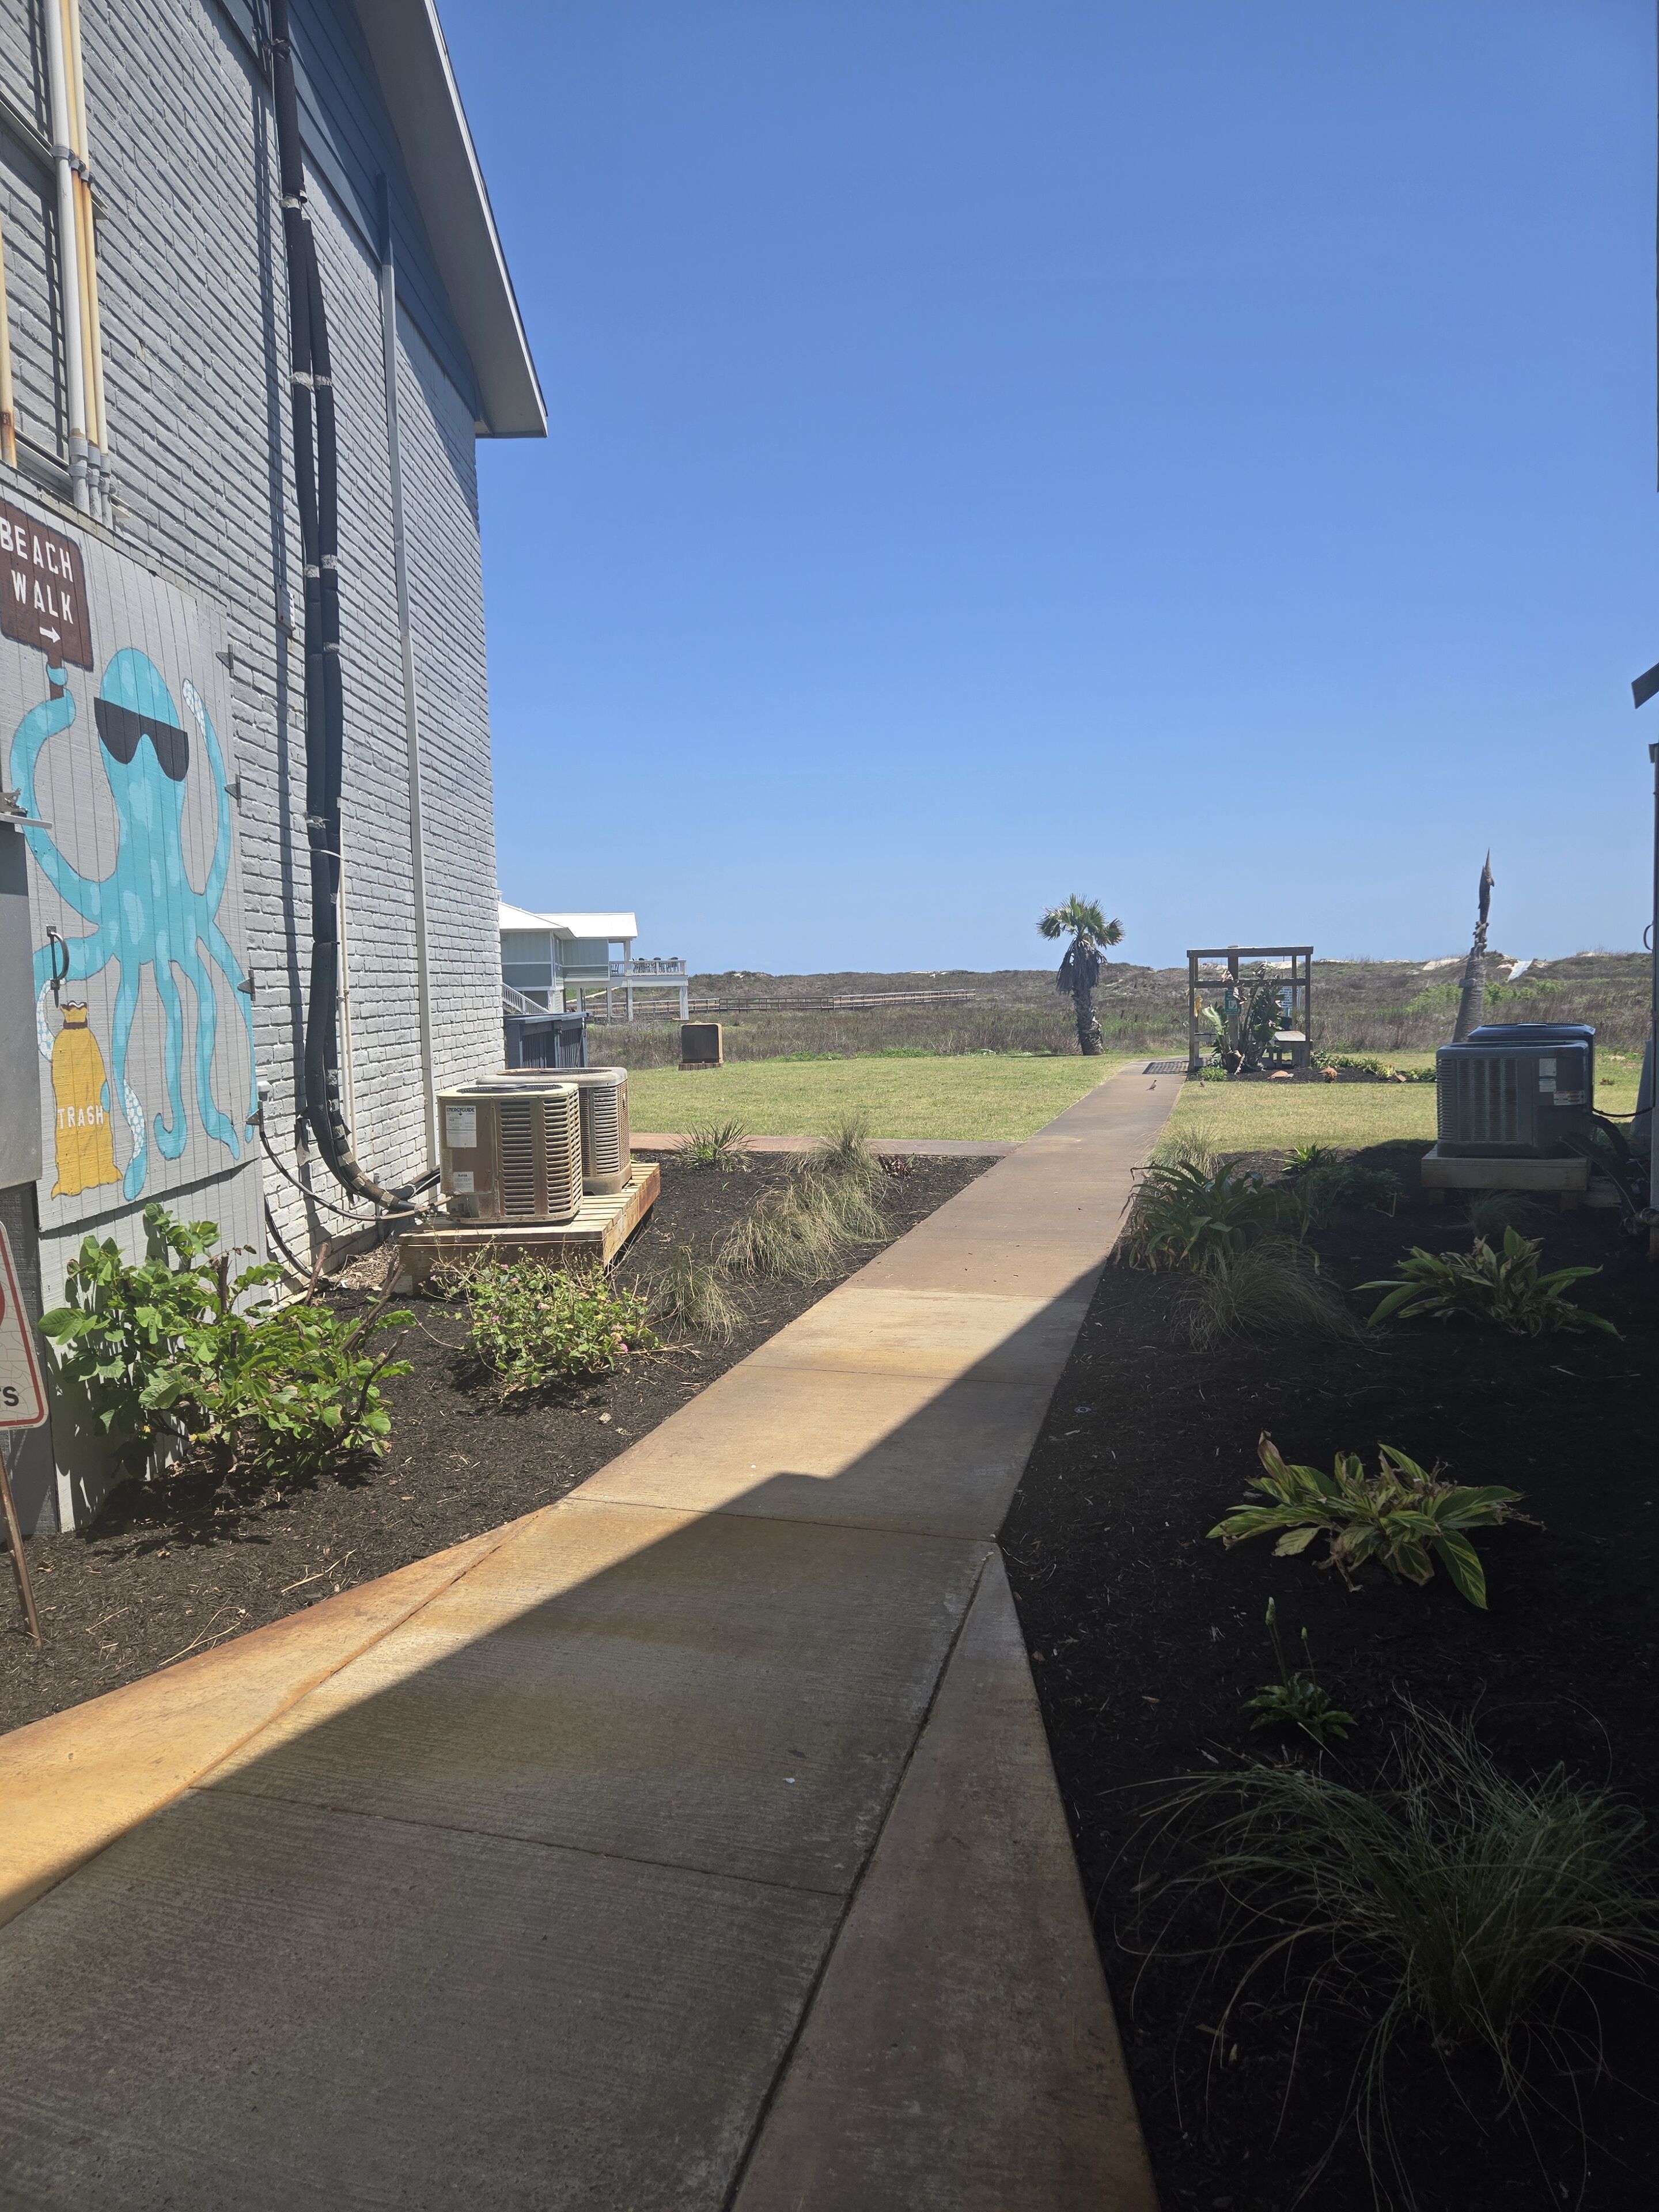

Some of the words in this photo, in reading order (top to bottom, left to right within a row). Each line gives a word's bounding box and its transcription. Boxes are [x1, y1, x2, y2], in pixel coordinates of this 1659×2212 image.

[0, 517, 73, 583] BEACH
[11, 569, 74, 624] WALK
[57, 1105, 104, 1130] TRASH
